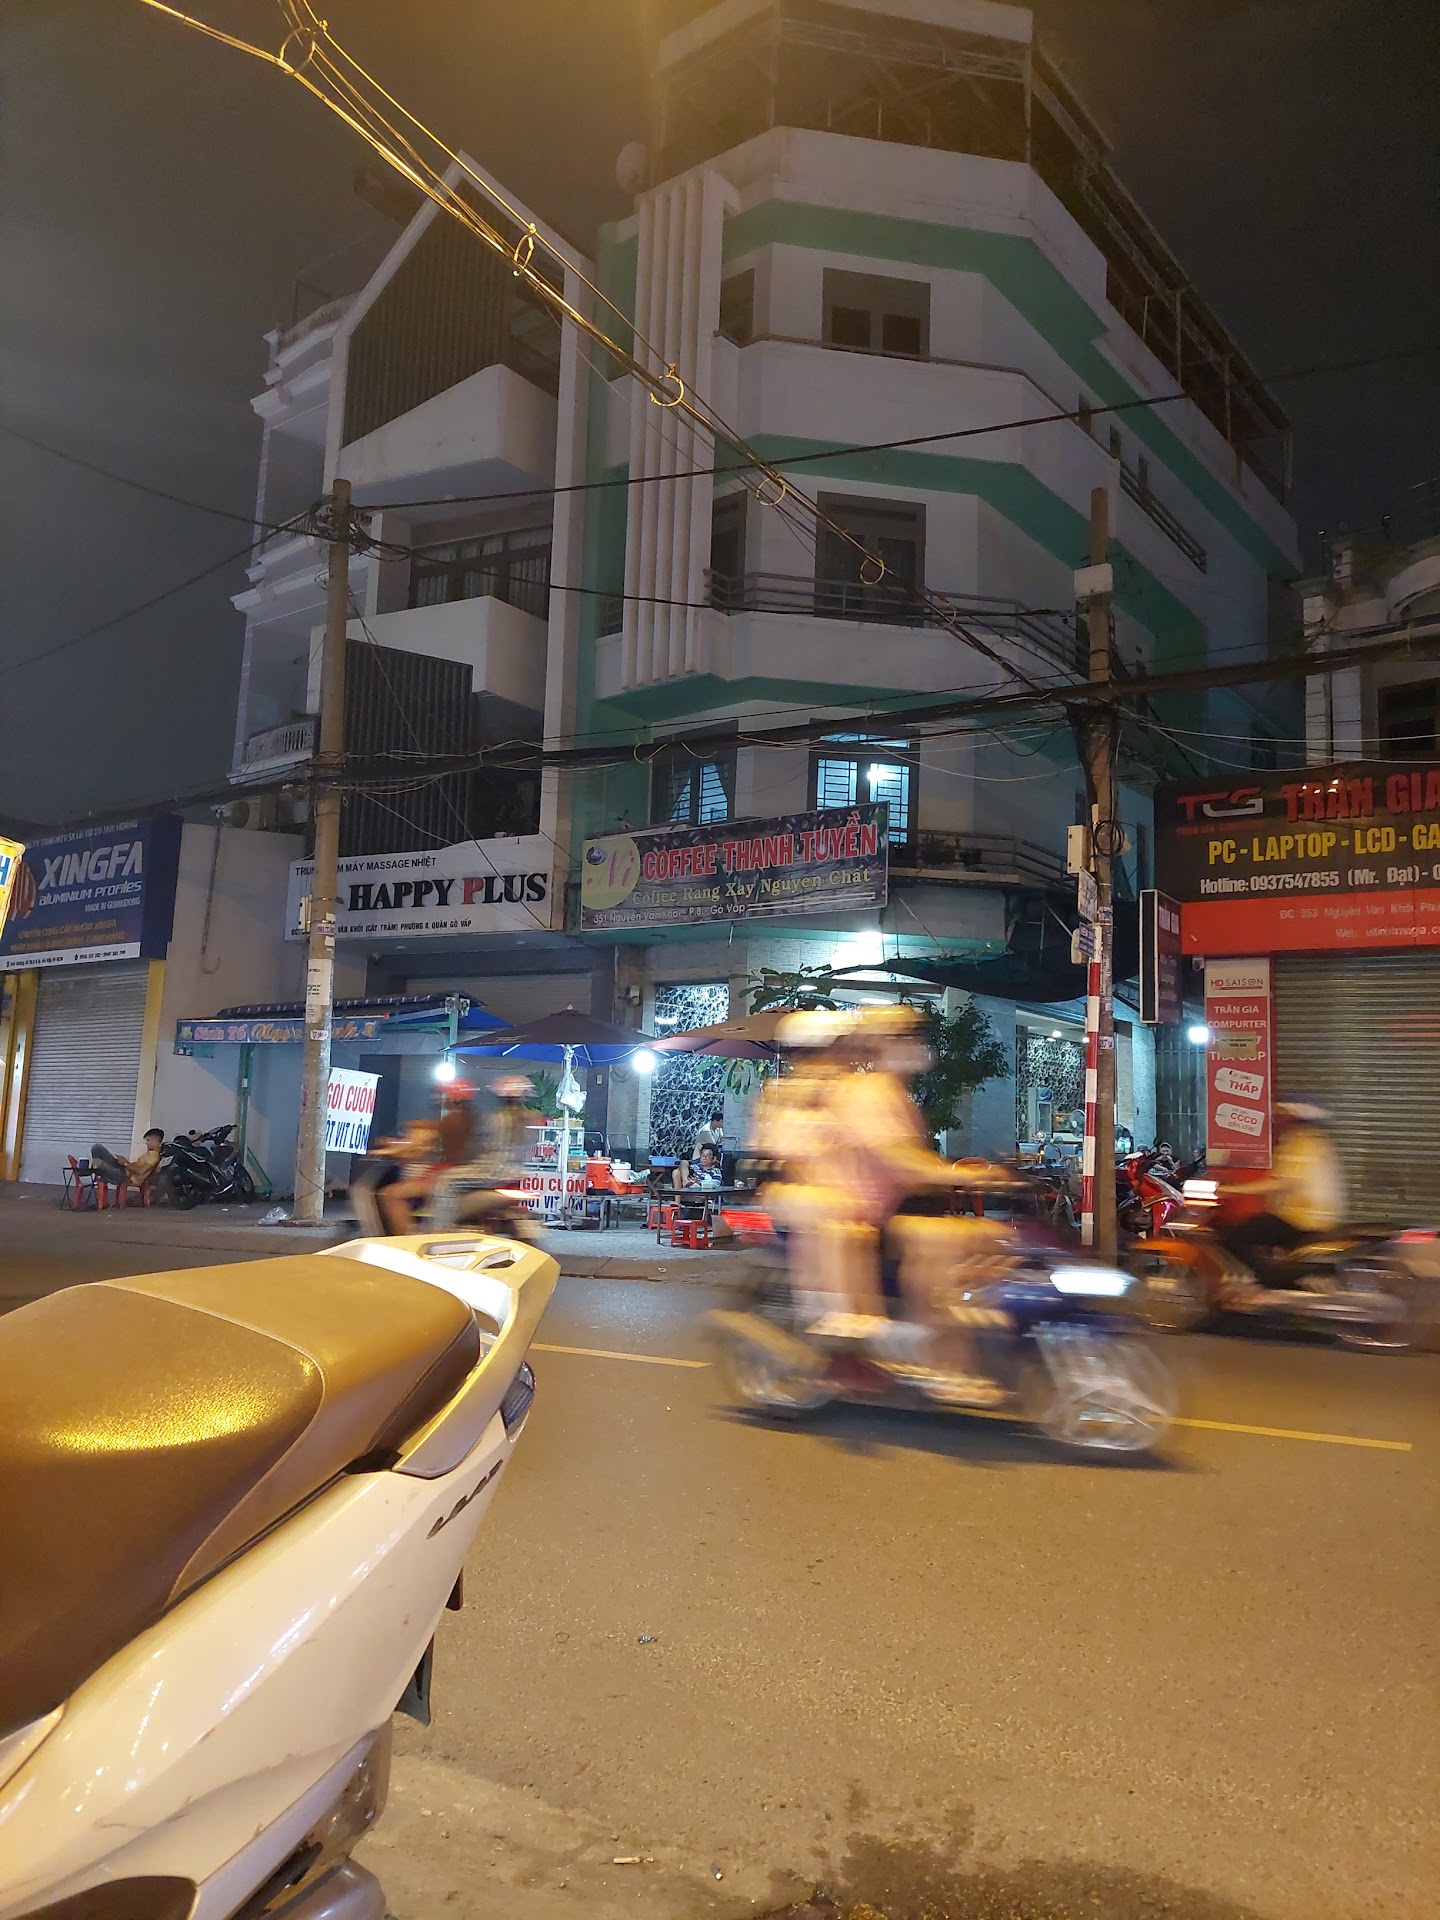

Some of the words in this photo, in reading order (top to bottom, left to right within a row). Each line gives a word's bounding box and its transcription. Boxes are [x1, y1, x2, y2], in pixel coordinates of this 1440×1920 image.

[643, 843, 718, 881] COFFEE
[722, 833, 794, 872] THANH
[799, 811, 878, 863] TUYỀN
[1208, 840, 1237, 865] PC
[1252, 832, 1337, 863] LAPTOP
[1354, 826, 1396, 855] LCD
[38, 841, 143, 890] XINGFA
[346, 861, 364, 872] MÁY
[366, 859, 410, 871] MASSAGE
[412, 856, 437, 868] NHIỆT
[1347, 868, 1380, 888] (Mr.
[347, 878, 455, 911] HAPPY
[462, 873, 547, 906] PLUS
[632, 889, 678, 906] Coffee
[682, 885, 721, 903] Rang
[725, 882, 755, 899] Xay
[760, 874, 822, 896] Nguyên
[593, 913, 607, 924] 351
[1210, 979, 1224, 987] HD
[1225, 978, 1264, 987] SAISON
[1241, 1005, 1260, 1014] GIA
[1207, 1020, 1267, 1029] COMPURTER
[1229, 1080, 1259, 1094] THẤP
[1230, 1112, 1258, 1125] CCCD
[522, 1172, 545, 1191] GỎI
